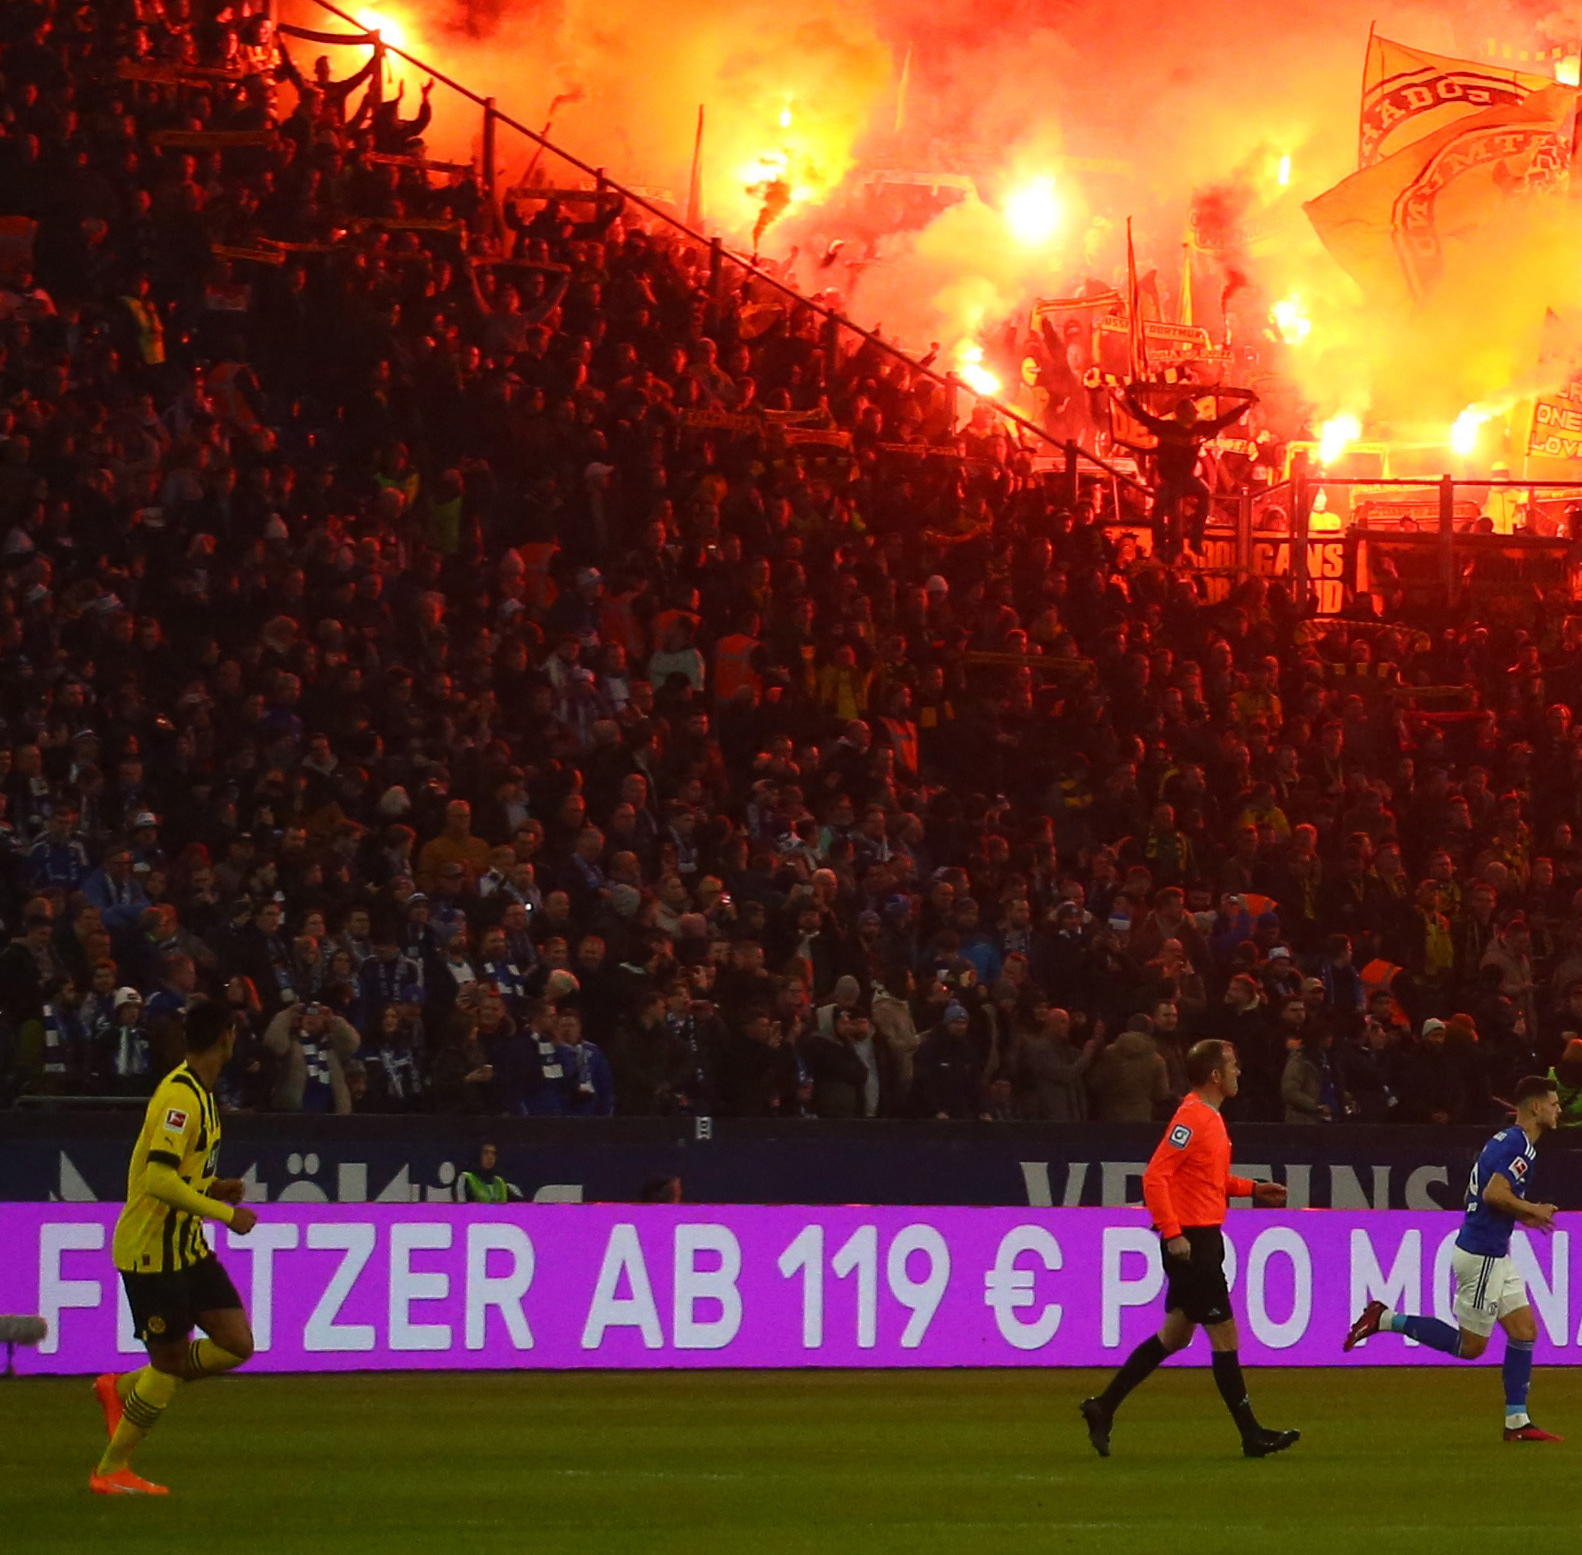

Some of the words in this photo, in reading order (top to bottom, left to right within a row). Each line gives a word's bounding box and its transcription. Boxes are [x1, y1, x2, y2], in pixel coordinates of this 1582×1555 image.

[1536, 403, 1582, 432] ONE
[38, 1223, 536, 1354] FTZER
[581, 1223, 743, 1350] AB
[777, 1223, 951, 1349] 119
[984, 1224, 1064, 1350] €
[1102, 1225, 1313, 1350] PO
